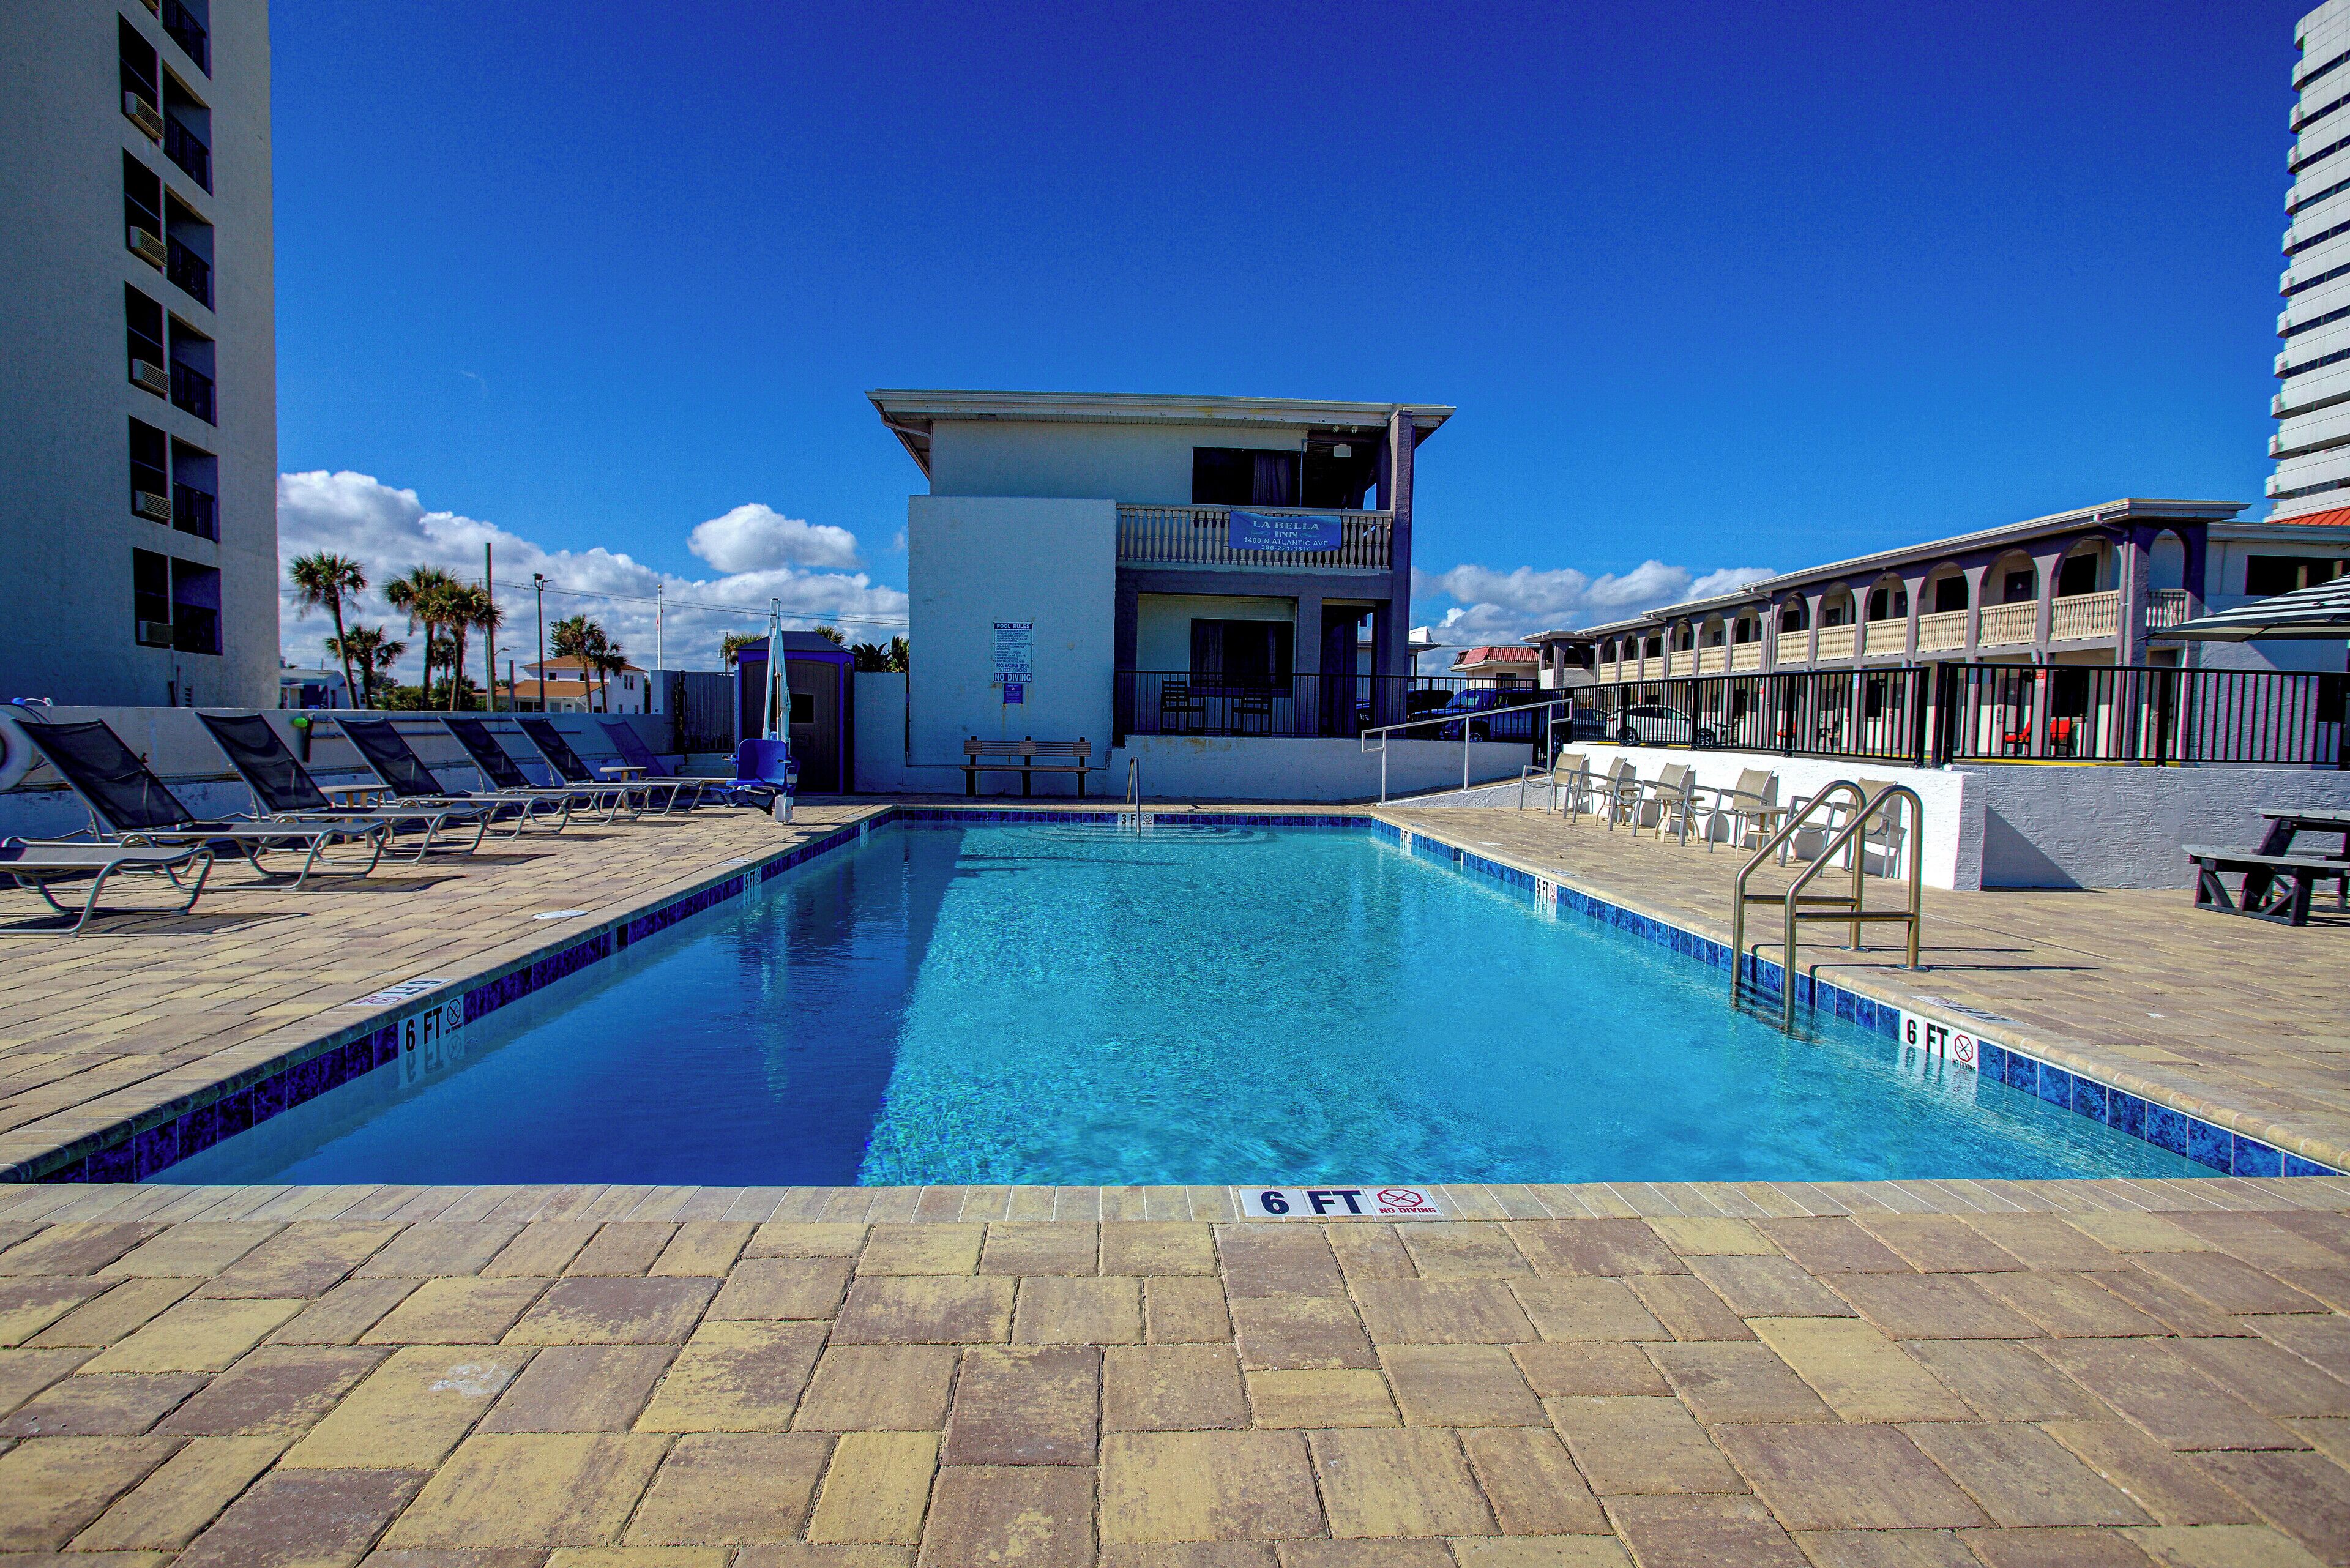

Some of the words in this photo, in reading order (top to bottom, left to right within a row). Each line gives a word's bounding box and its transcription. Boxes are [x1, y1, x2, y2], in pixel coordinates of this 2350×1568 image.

[1121, 814, 1127, 824] 3
[406, 1018, 416, 1052] 6
[423, 1006, 442, 1045] FT
[1907, 1018, 1917, 1045] 6
[1926, 1022, 1949, 1058] FT
[1261, 1190, 1289, 1214] 6
[1307, 1190, 1362, 1214] FT
